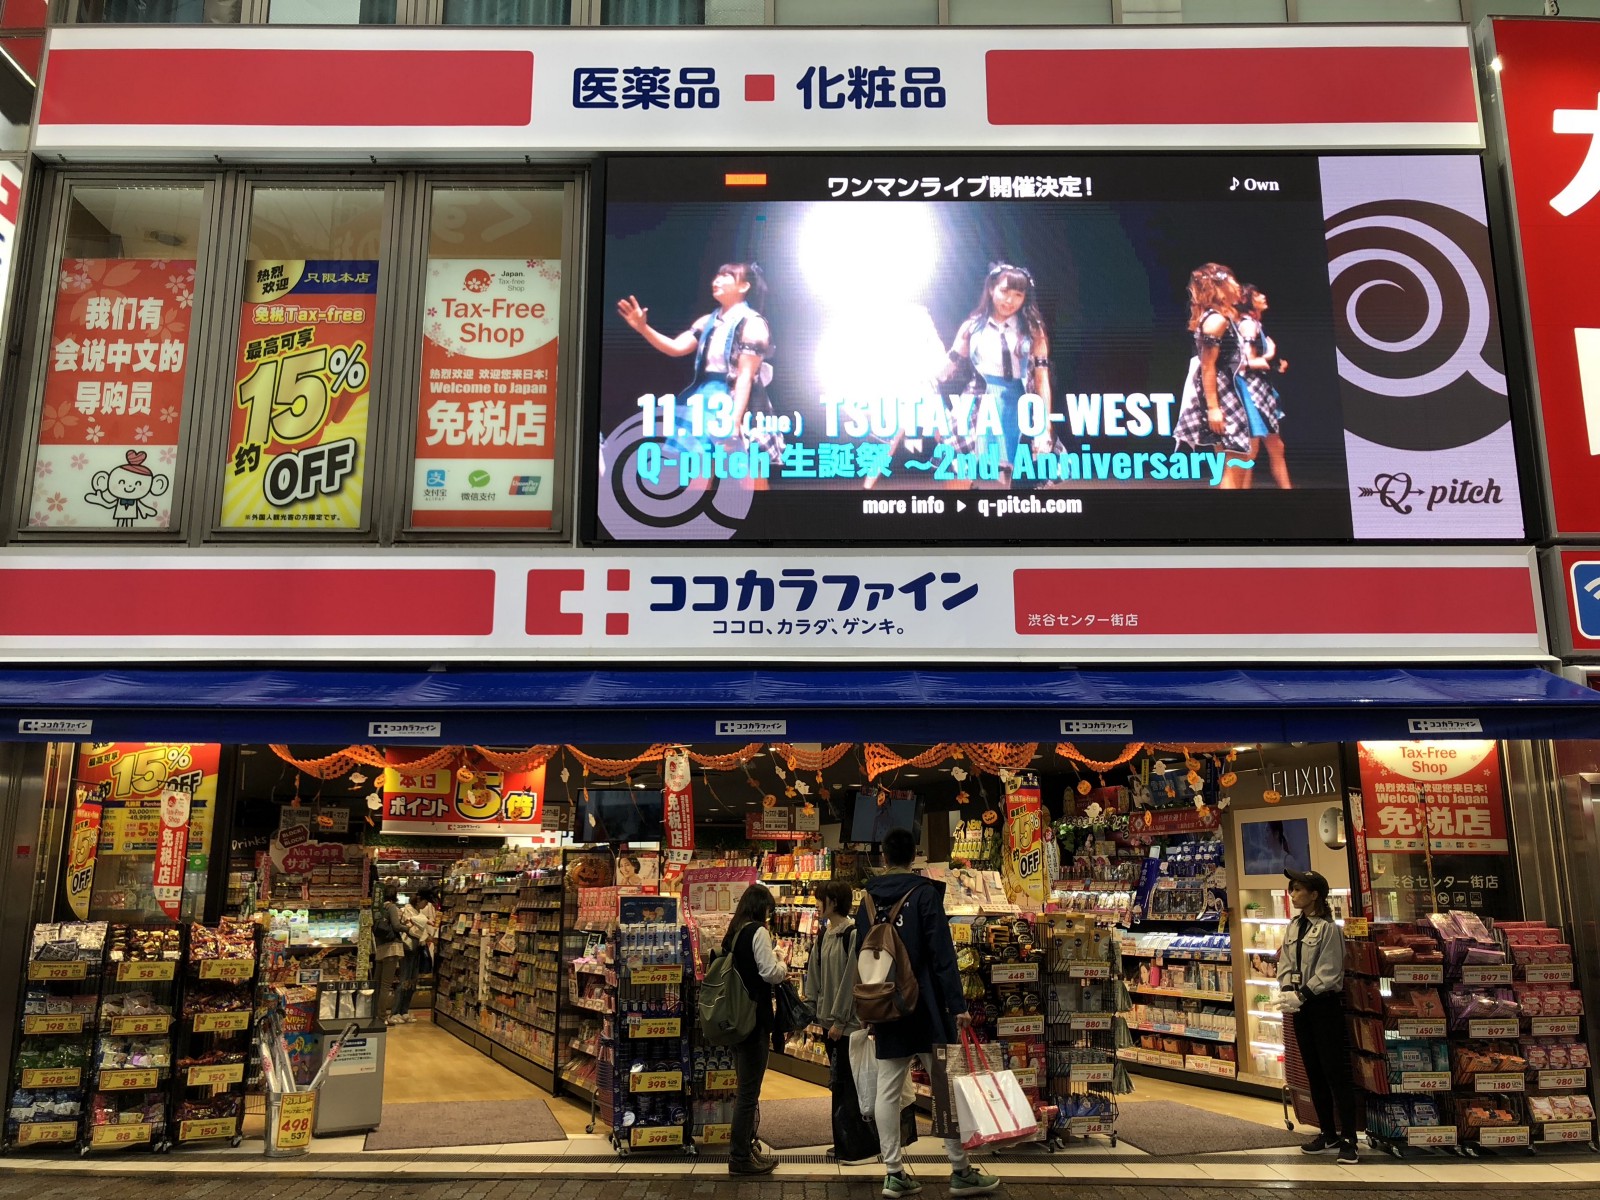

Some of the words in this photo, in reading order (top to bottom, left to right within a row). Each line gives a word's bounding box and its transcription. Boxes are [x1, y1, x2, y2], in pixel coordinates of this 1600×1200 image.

[572, 66, 720, 110] 医薬品
[797, 65, 946, 110] 化粧品
[827, 176, 1093, 198] ワンマンライブ開催決定!
[1244, 179, 1279, 191] Own
[262, 278, 290, 295] 欢迎
[304, 272, 371, 284] 只限本店
[85, 296, 164, 331] 我们有
[441, 298, 546, 318] Tax-Free
[246, 328, 314, 360] 最高可享
[460, 323, 525, 347] Shop
[54, 338, 184, 373] 会说中文的
[75, 381, 153, 416] 导购员
[430, 382, 491, 394] Welcome
[494, 383, 507, 394] to
[509, 382, 547, 395] Japan
[426, 400, 547, 447] 免税店
[637, 393, 736, 438] 11.13
[820, 393, 1003, 438] TSUTAYA
[234, 444, 260, 476] 约
[637, 442, 770, 486] Q-pitch
[781, 442, 892, 478] 生誕祭
[266, 439, 356, 505] OFF
[461, 493, 496, 501] 微信支付
[1374, 472, 1412, 514] Q
[1427, 478, 1503, 511] pitch
[862, 498, 906, 514] more
[910, 496, 945, 514] info
[977, 496, 1082, 516] q-pitch.com
[649, 569, 979, 612] ココカラファイン
[713, 619, 905, 635] ココロ、カラダ、ゲンキ。
[1028, 613, 1138, 627] 渋谷センター街店
[1399, 746, 1457, 759] Tax-Free
[1411, 761, 1448, 775] Shop
[1272, 765, 1336, 798] ELIXIR
[390, 797, 448, 817] ポイント
[1377, 794, 1434, 804] Welcoe
[1438, 795, 1450, 804] to
[1452, 793, 1489, 805] Japan
[560, 813, 568, 823] 2
[667, 793, 683, 847] 免税店
[1378, 806, 1492, 836] 免税店
[157, 828, 174, 885] 免税店
[1020, 850, 1040, 877] OFF
[71, 869, 92, 895] OFF
[50, 969, 68, 977] 198
[140, 970, 154, 978] 58
[1488, 1027, 1505, 1035] 897
[40, 1131, 58, 1139] 178
[281, 1117, 309, 1132] 498
[291, 1131, 306, 1140] 537
